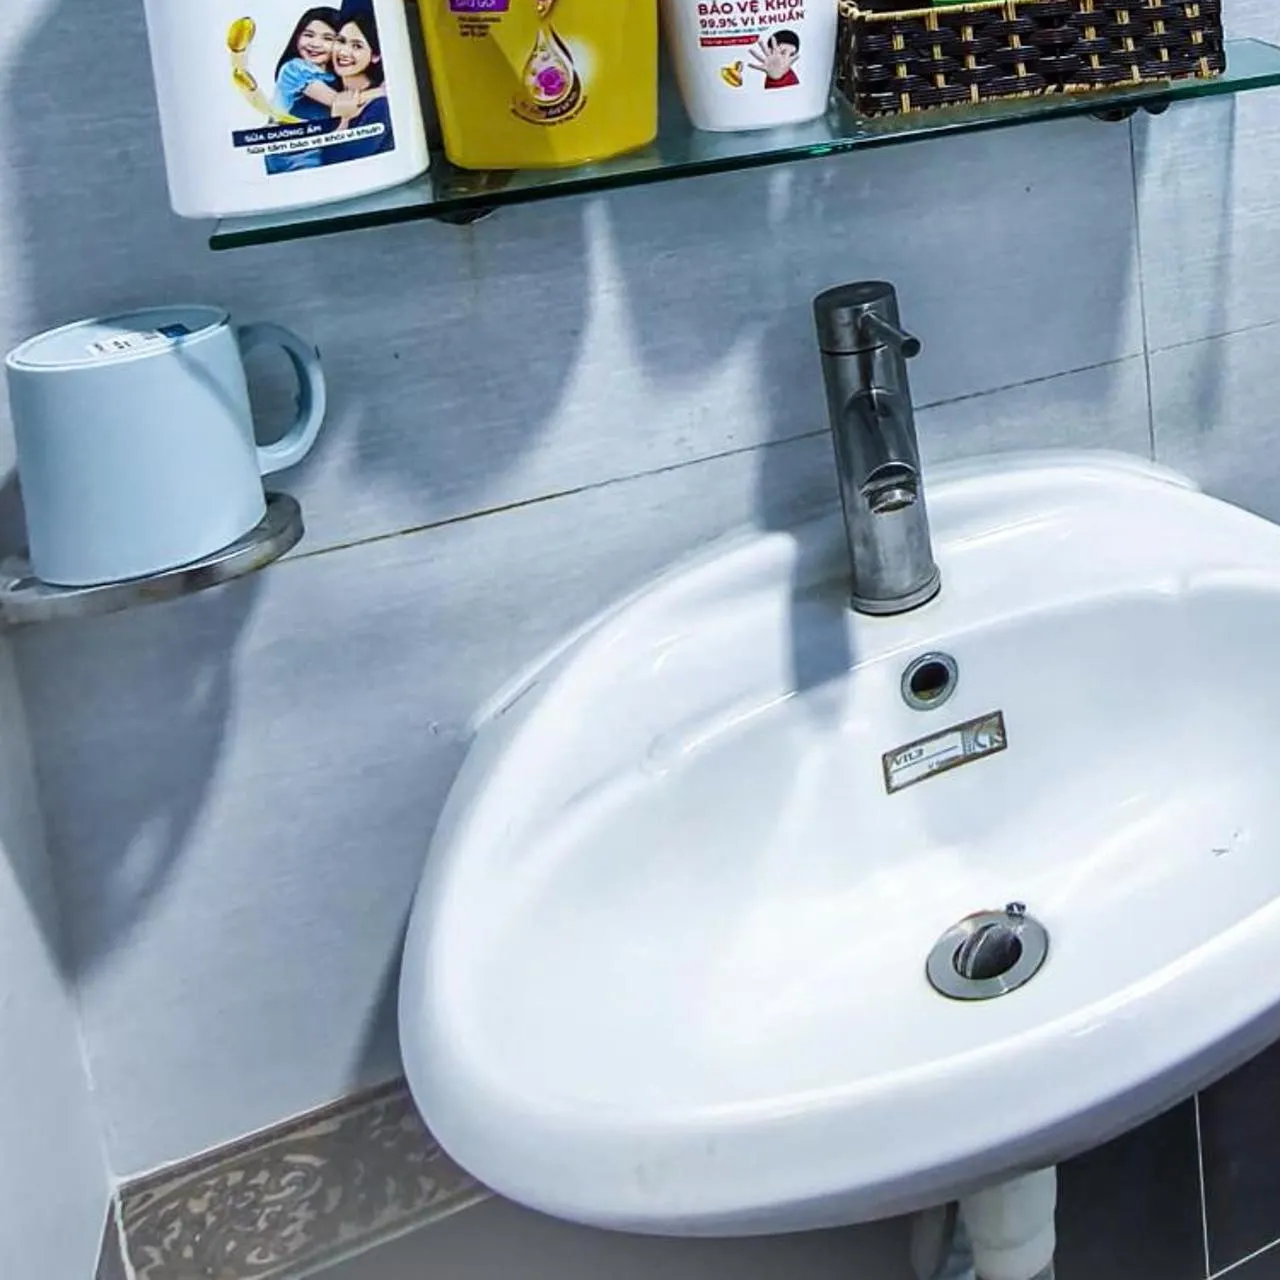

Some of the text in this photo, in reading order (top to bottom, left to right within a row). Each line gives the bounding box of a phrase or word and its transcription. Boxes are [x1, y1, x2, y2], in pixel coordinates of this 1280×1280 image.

[698, 1, 734, 16] BẢO
[699, 18, 738, 28] 99.9%
[741, 17, 755, 26] VI
